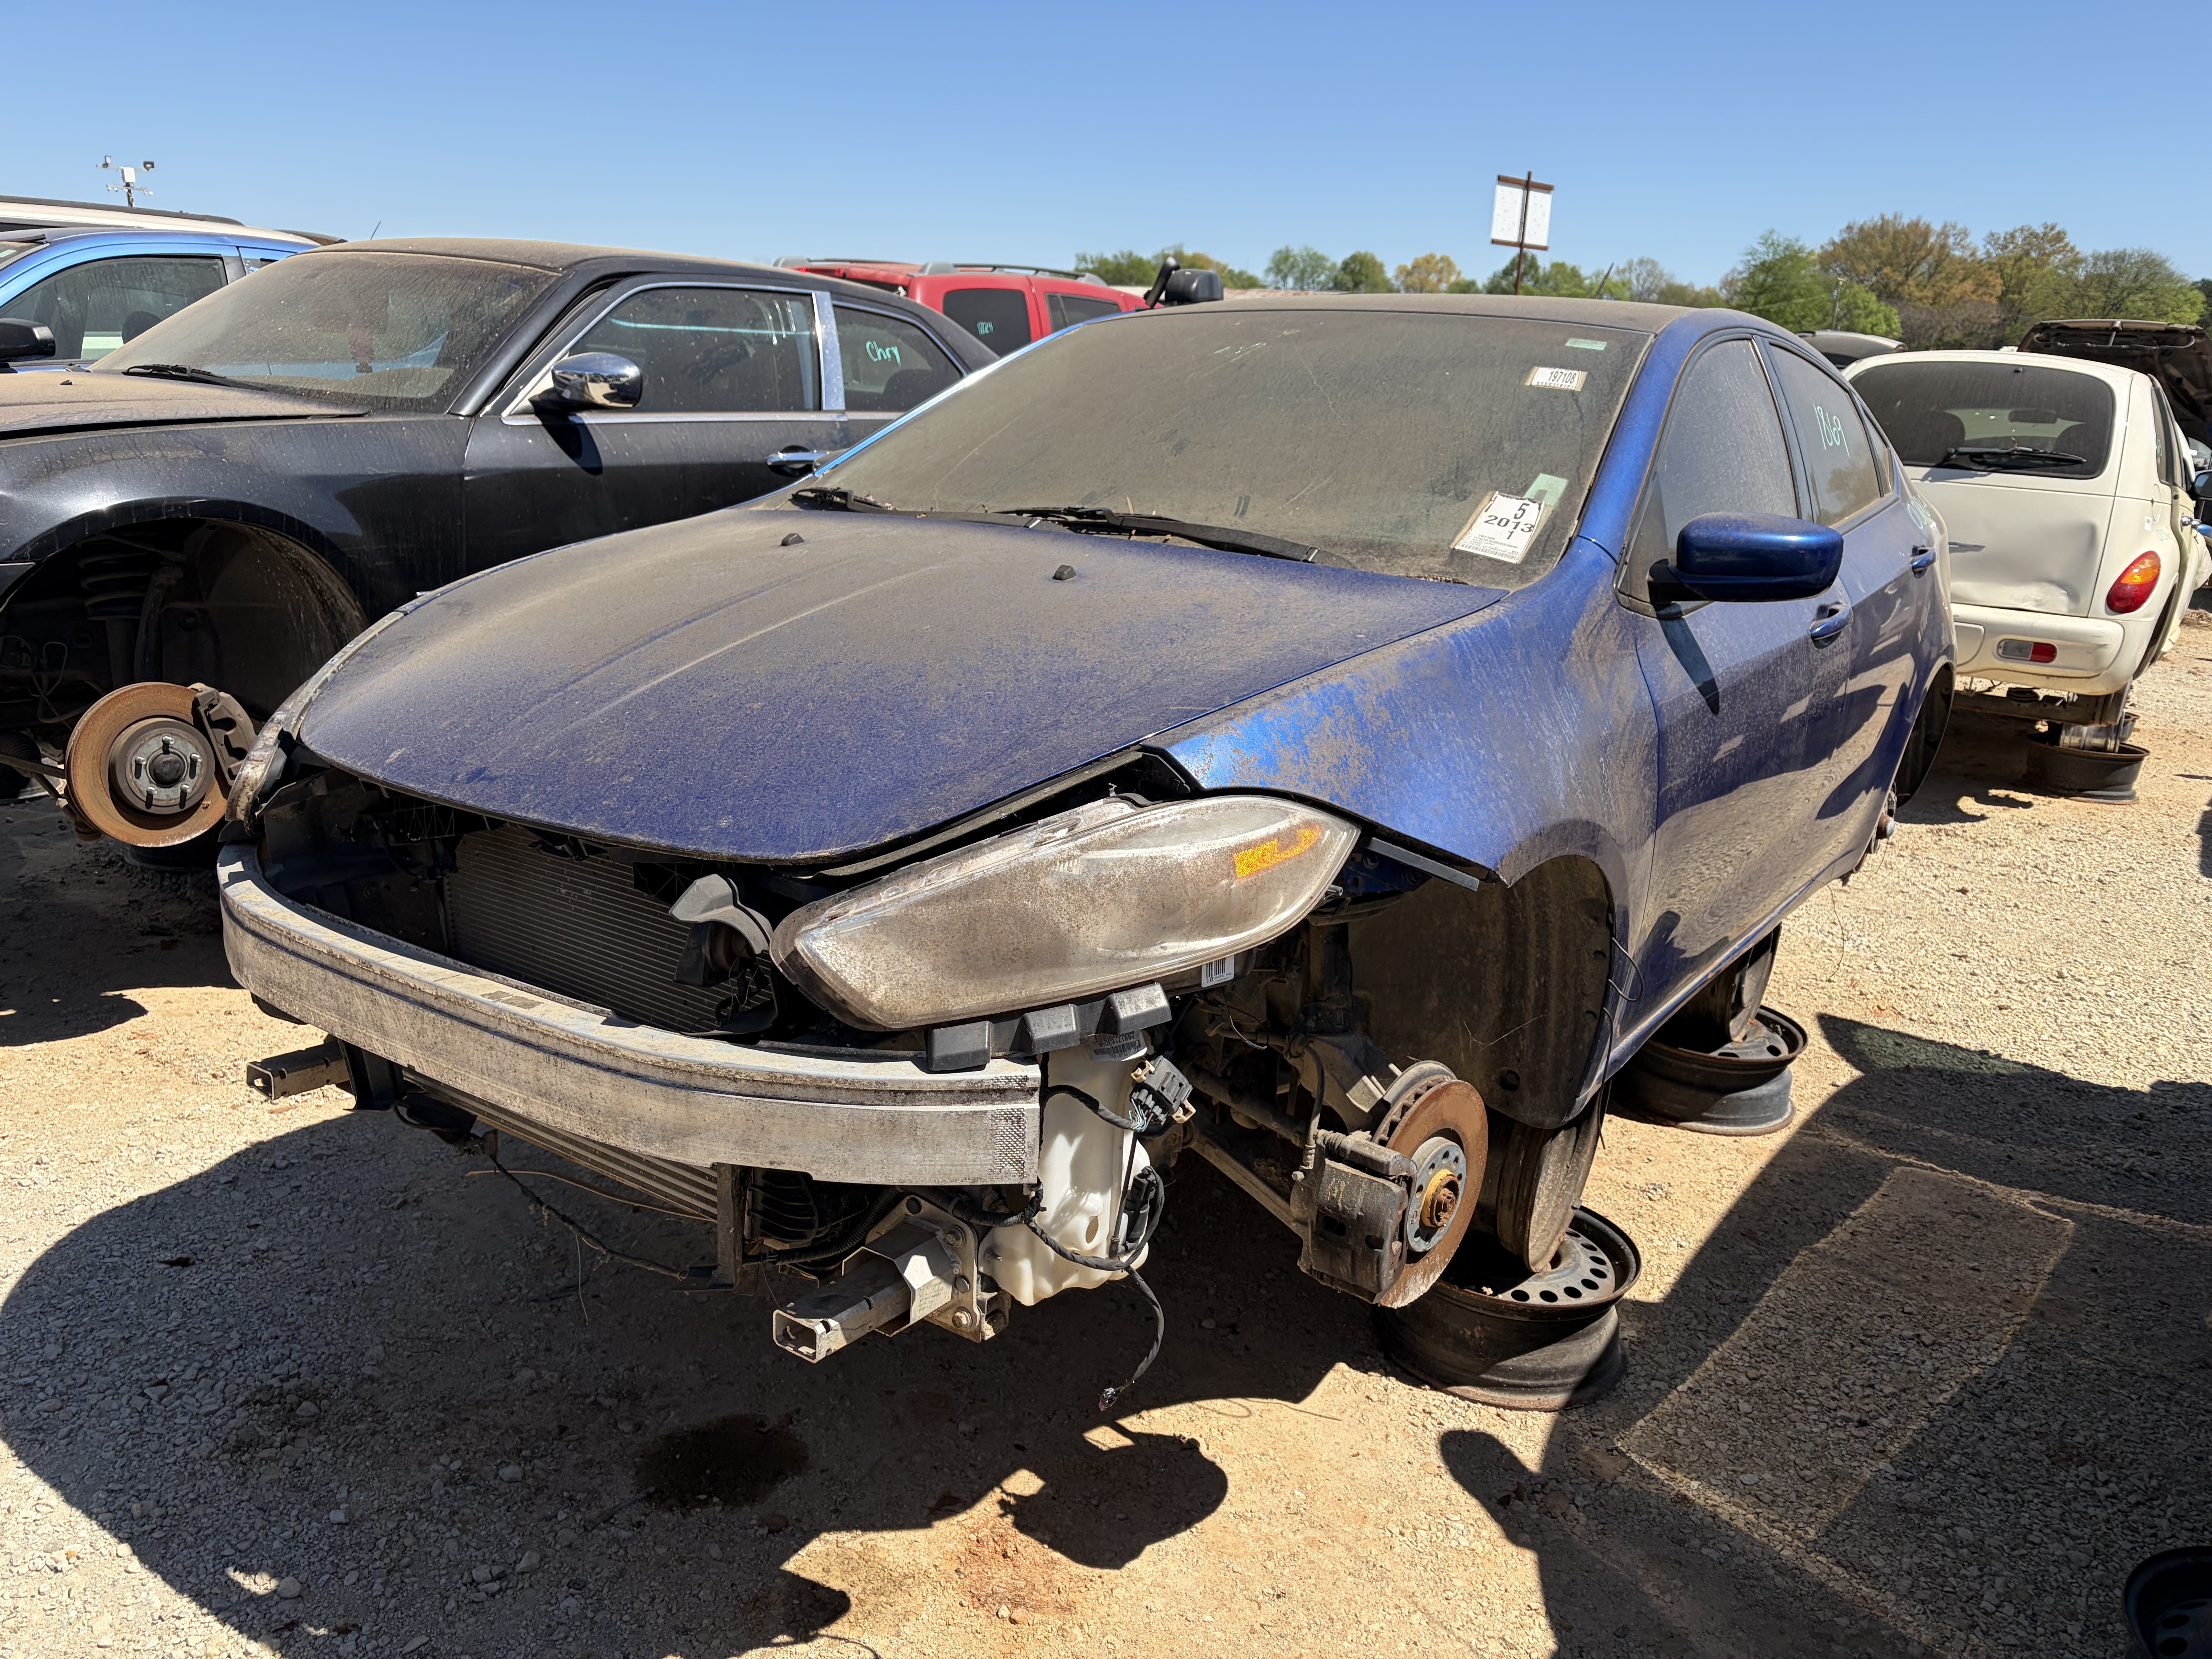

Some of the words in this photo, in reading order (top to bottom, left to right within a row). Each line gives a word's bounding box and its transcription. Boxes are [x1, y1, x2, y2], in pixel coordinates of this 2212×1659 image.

[866, 340, 902, 368] Chry
[1548, 371, 1577, 384] 197108
[1513, 503, 1530, 520] 5
[1483, 515, 1535, 532] 2013
[1506, 530, 1515, 540] 1
